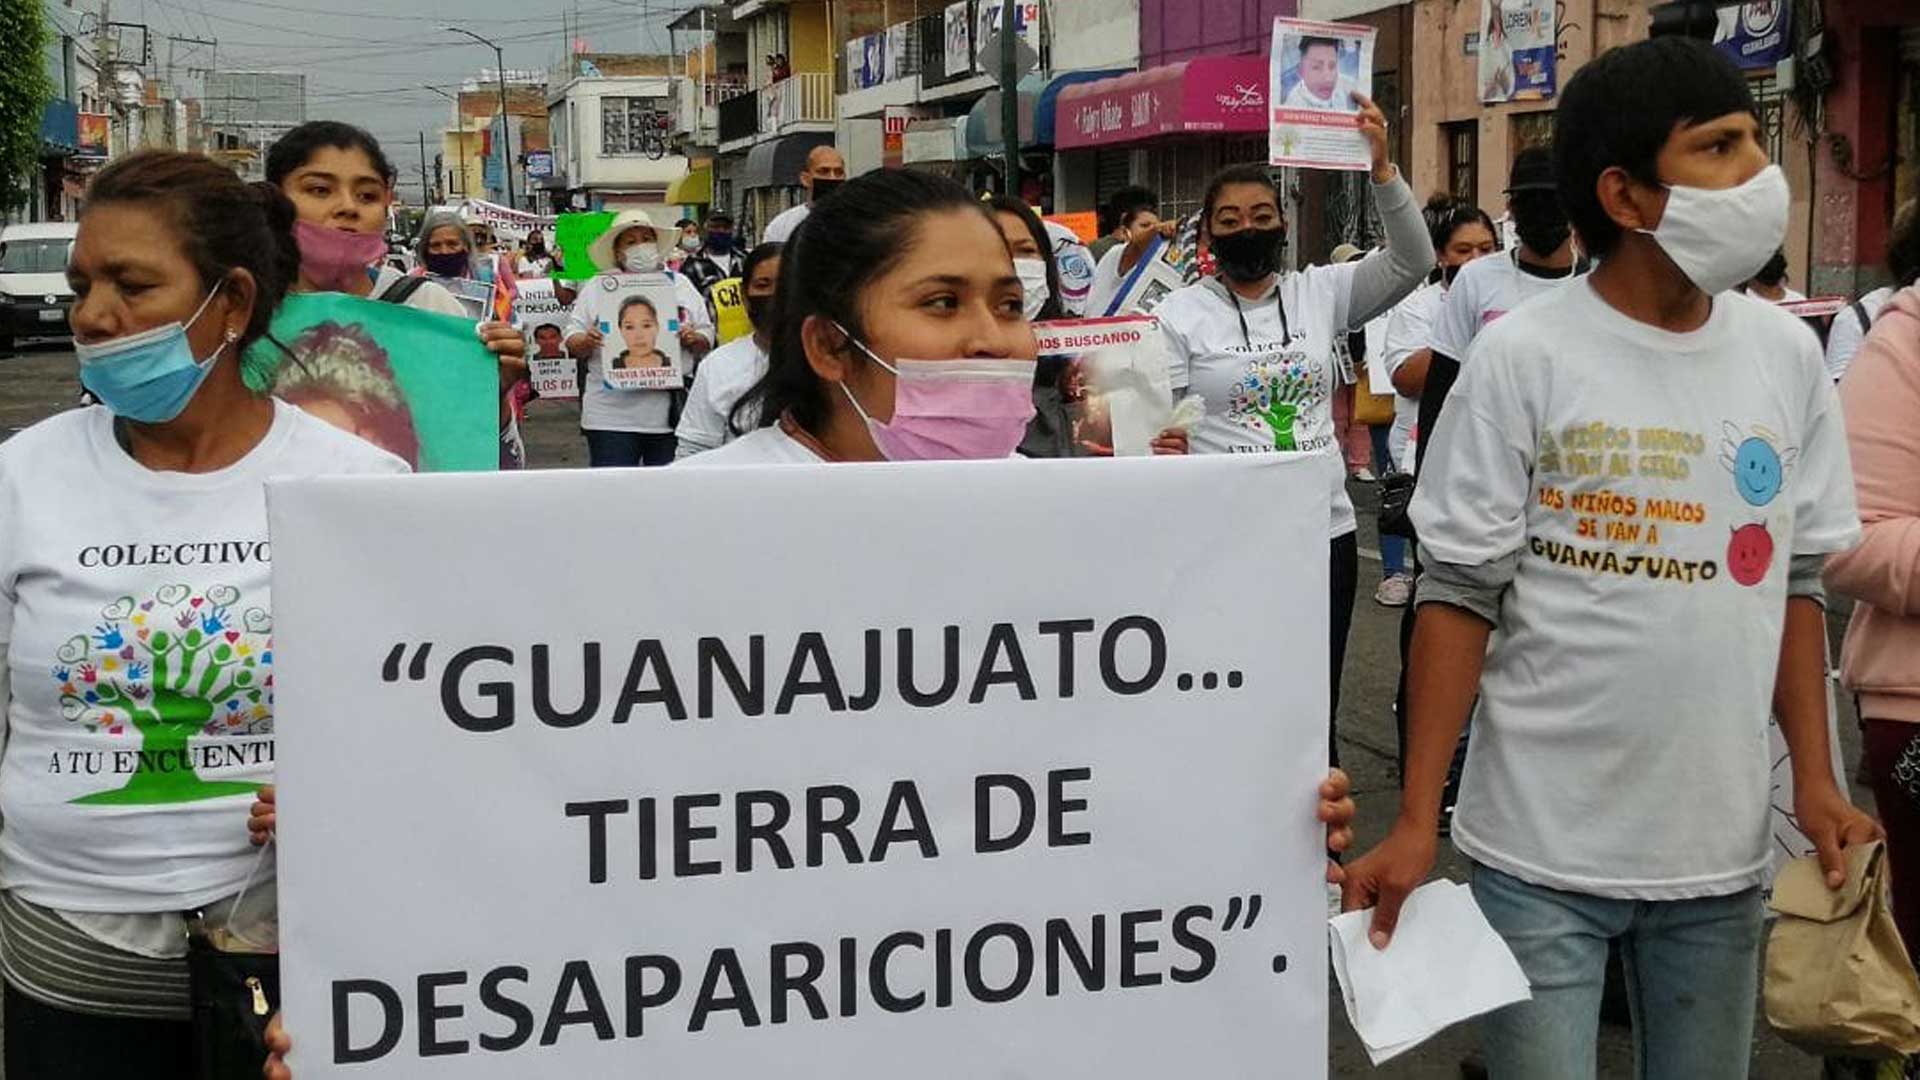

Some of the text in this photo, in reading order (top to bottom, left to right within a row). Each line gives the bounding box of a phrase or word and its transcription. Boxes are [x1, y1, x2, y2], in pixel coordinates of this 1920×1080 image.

[1064, 330, 1141, 348] BUSCANDO
[1539, 488, 1707, 523] LOS NIÑOS MALOS
[1577, 518, 1658, 544] SE VAN A
[78, 541, 272, 568] COLECTIVO
[1531, 536, 1717, 583] GUANAJUATO
[48, 740, 275, 774] A TU ENCUENT
[564, 767, 1092, 884] TIERRA DE
